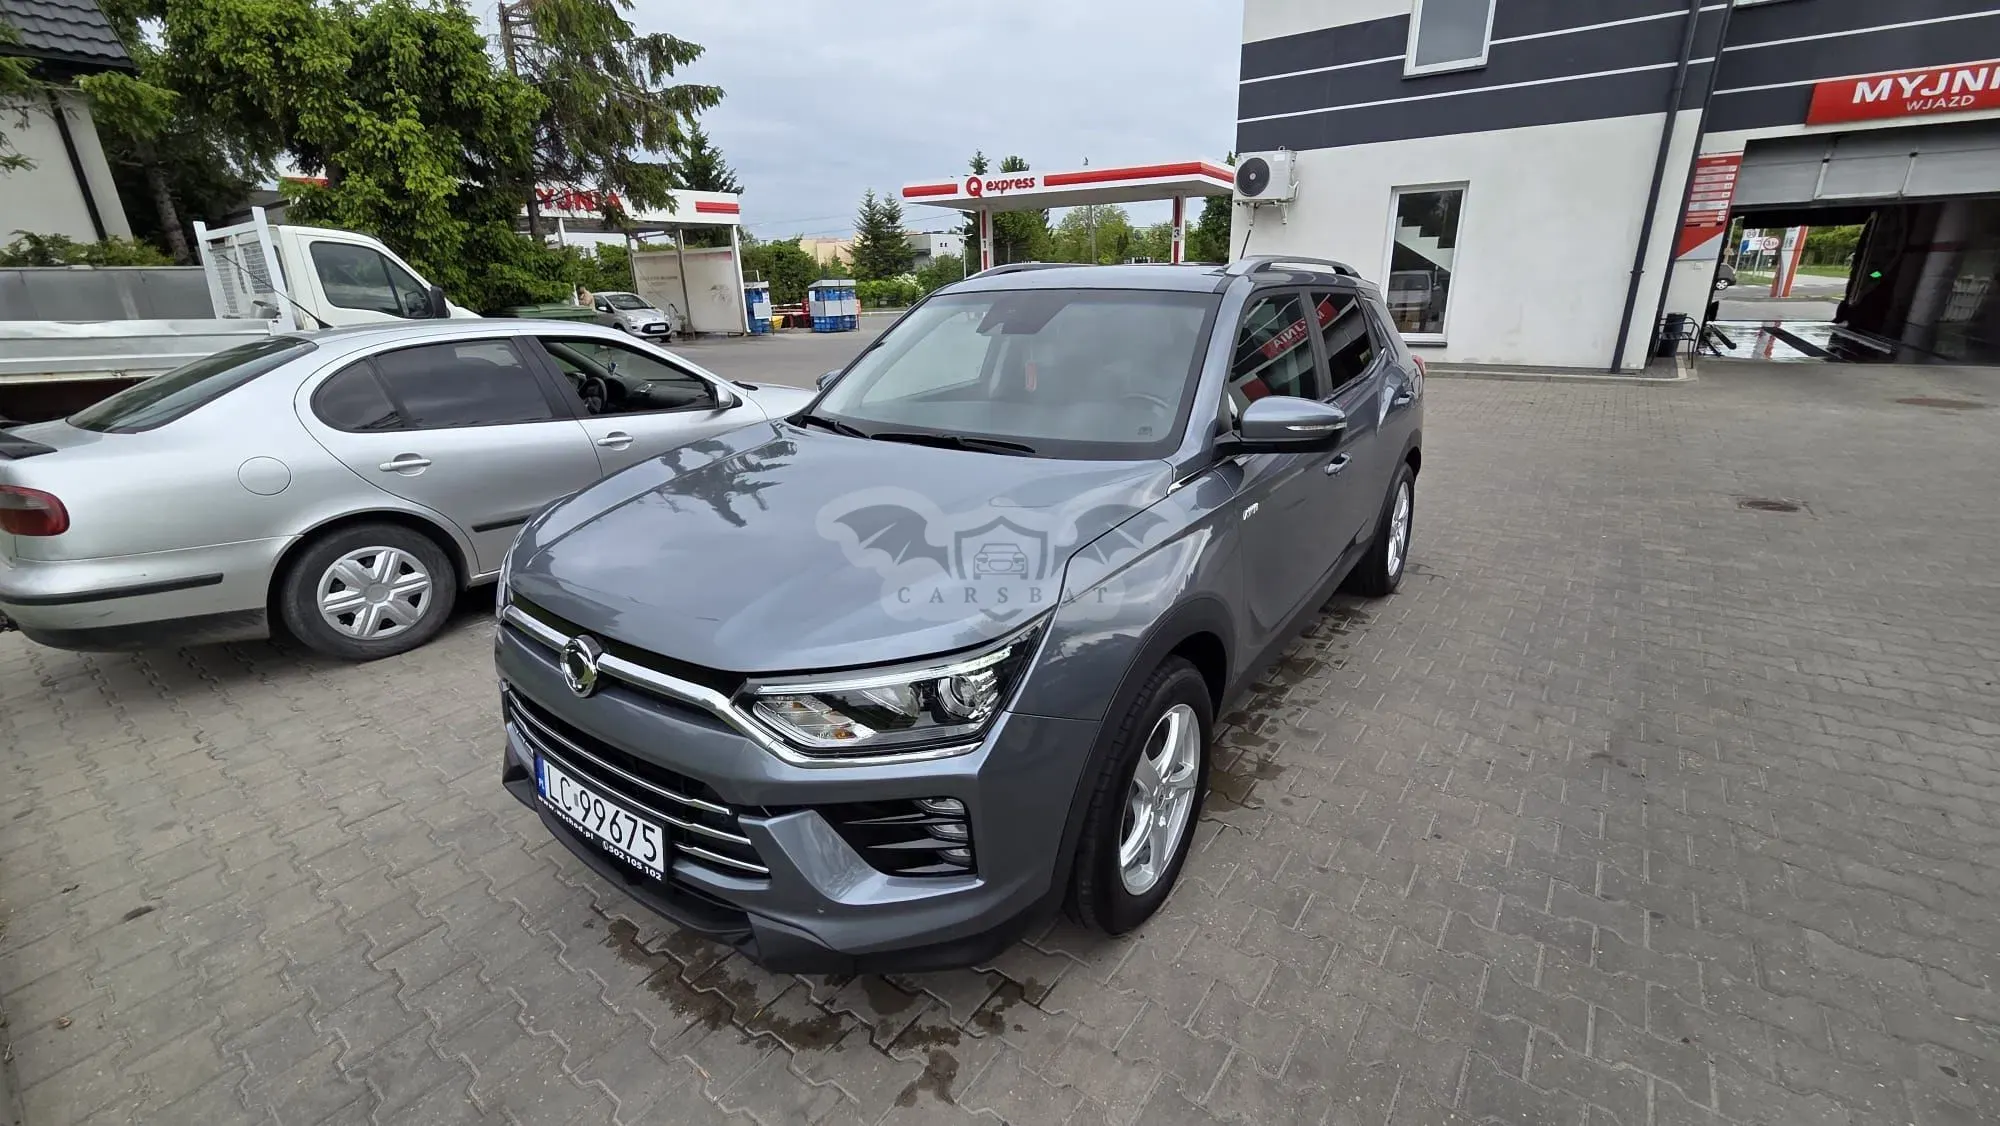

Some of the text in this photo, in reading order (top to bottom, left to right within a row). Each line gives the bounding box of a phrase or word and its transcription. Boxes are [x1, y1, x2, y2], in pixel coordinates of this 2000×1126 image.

[1906, 95, 1975, 112] WJAZD
[966, 176, 1036, 198] Q express
[547, 765, 657, 862] LC 99675
[608, 846, 625, 859] 502
[626, 855, 643, 870] 105
[645, 865, 663, 881] 102
